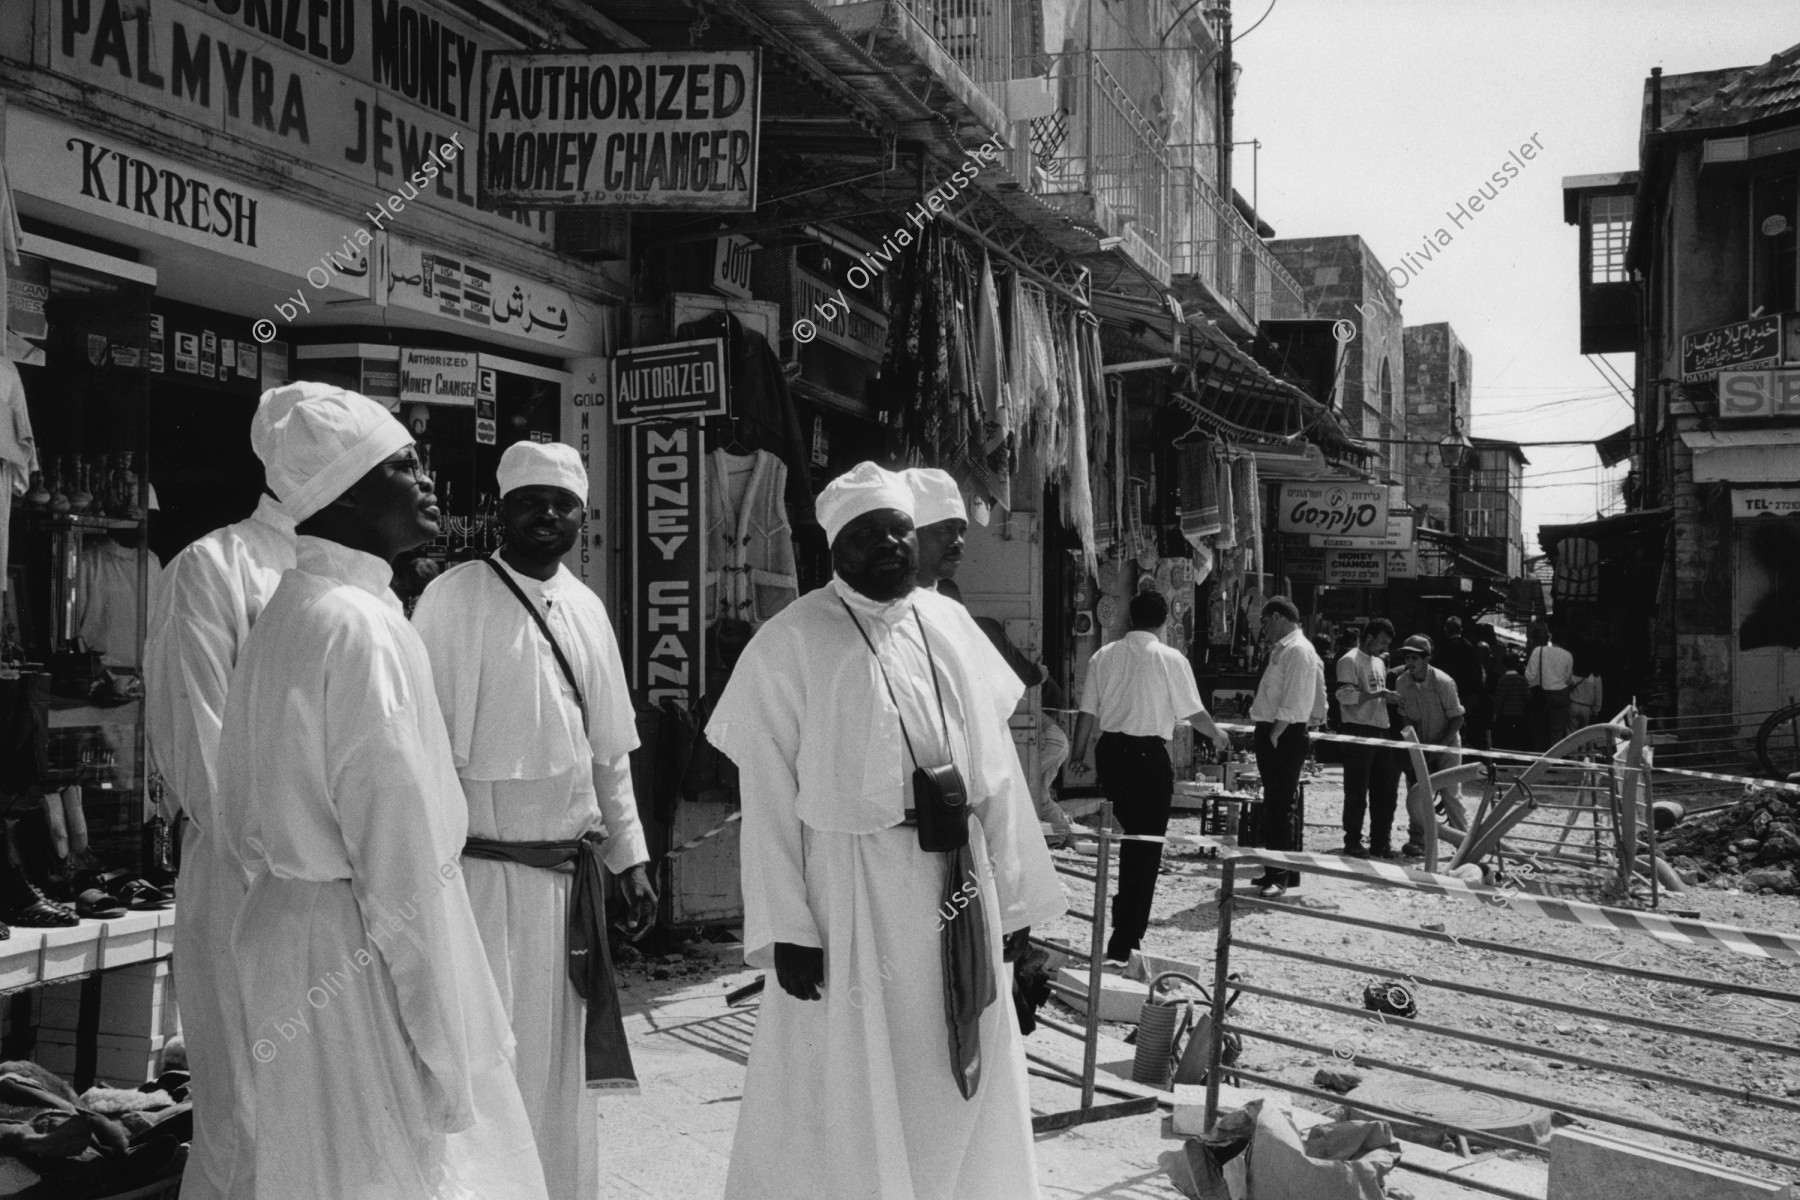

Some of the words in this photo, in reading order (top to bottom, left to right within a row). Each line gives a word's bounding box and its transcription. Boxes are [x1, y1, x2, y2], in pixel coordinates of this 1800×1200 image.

[62, 0, 310, 144] PALMYRA
[214, 0, 354, 65] RIZED
[372, 0, 477, 123] MONEY
[490, 64, 745, 121] AUTHORIZED
[488, 131, 598, 191] MONEY
[604, 130, 750, 192] CHANGER
[66, 138, 258, 248] KIRRESH
[7, 280, 48, 298] RICAN
[408, 352, 468, 368] AUTHORIZED
[401, 370, 433, 394] MONEY
[435, 373, 477, 397] CHANGER
[573, 393, 605, 407] GOLD
[618, 361, 715, 403] AUTORIZED
[647, 429, 689, 560] MONEY
[1331, 560, 1379, 568] CHANGER
[1338, 552, 1374, 560] MONEY
